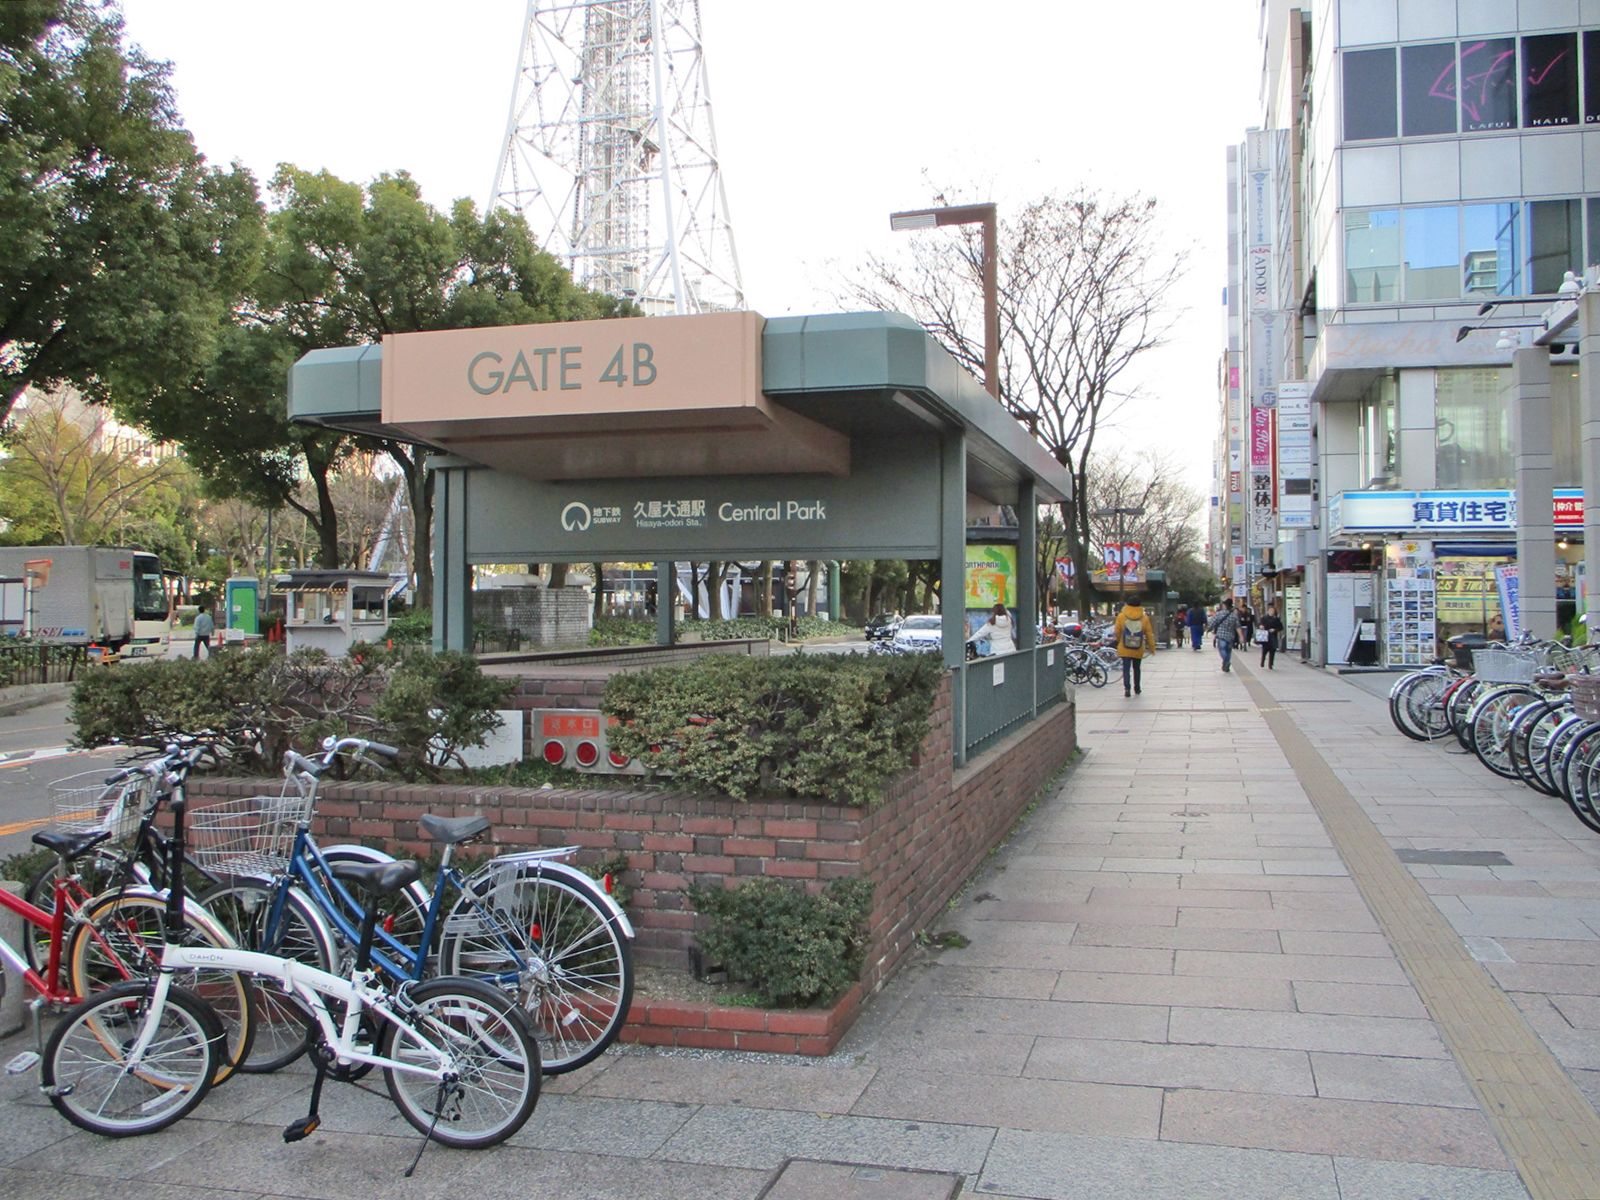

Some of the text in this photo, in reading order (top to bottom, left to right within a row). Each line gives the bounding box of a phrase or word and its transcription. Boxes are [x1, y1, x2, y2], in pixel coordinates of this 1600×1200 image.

[1532, 116, 1569, 125] HAIR
[467, 342, 658, 396] GATE 4B
[1254, 475, 1271, 507] 整体
[592, 507, 621, 517] 地下鉄
[633, 500, 706, 518] 久屋大通駅
[718, 500, 827, 521] Central Park
[1412, 501, 1507, 522] 賃貸住宅
